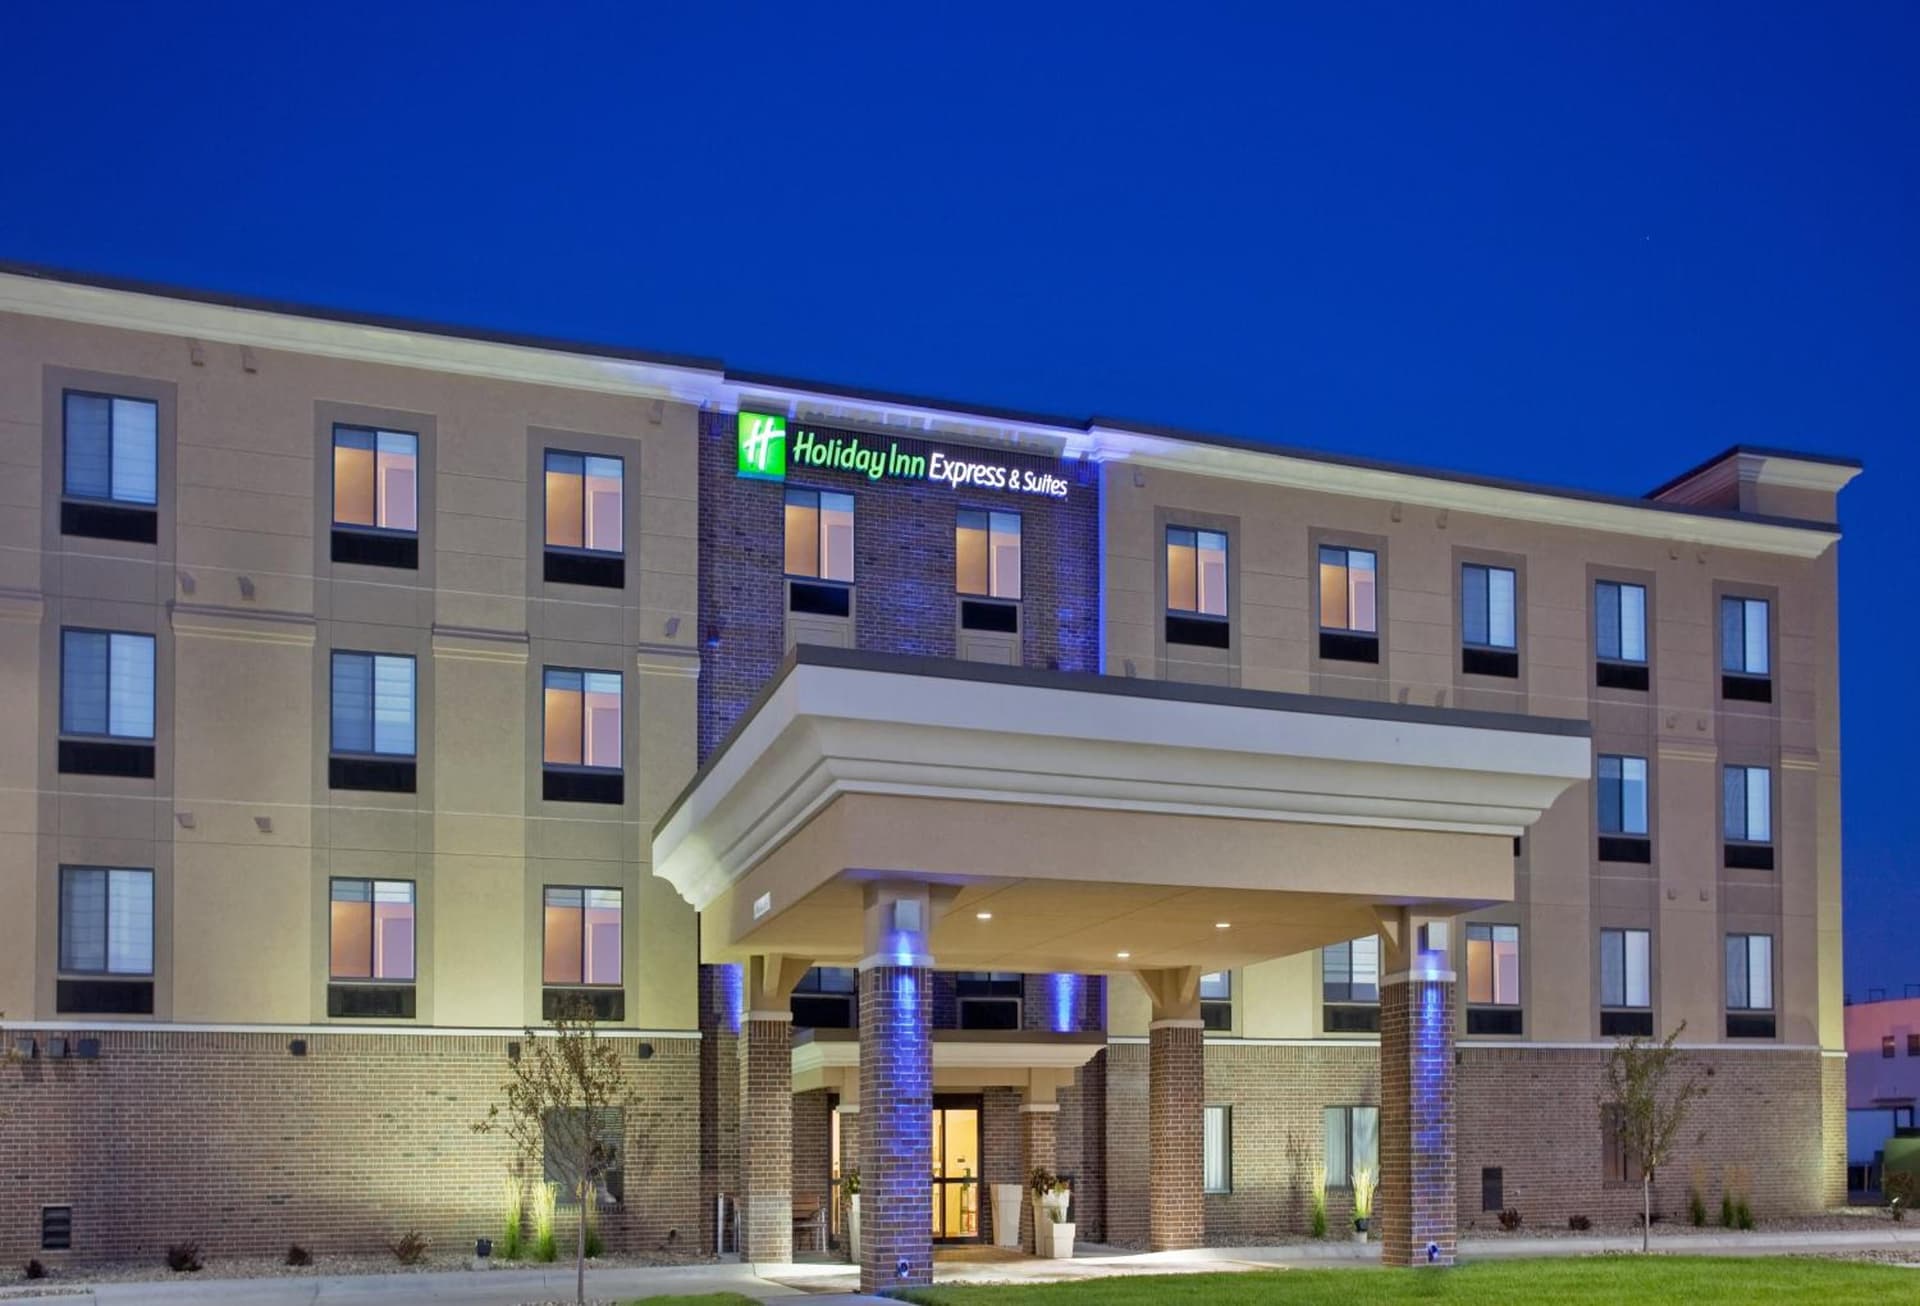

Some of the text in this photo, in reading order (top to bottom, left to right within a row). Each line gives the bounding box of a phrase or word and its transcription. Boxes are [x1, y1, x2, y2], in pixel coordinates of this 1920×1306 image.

[793, 431, 1068, 496] Holiday Inn Express & Suites
